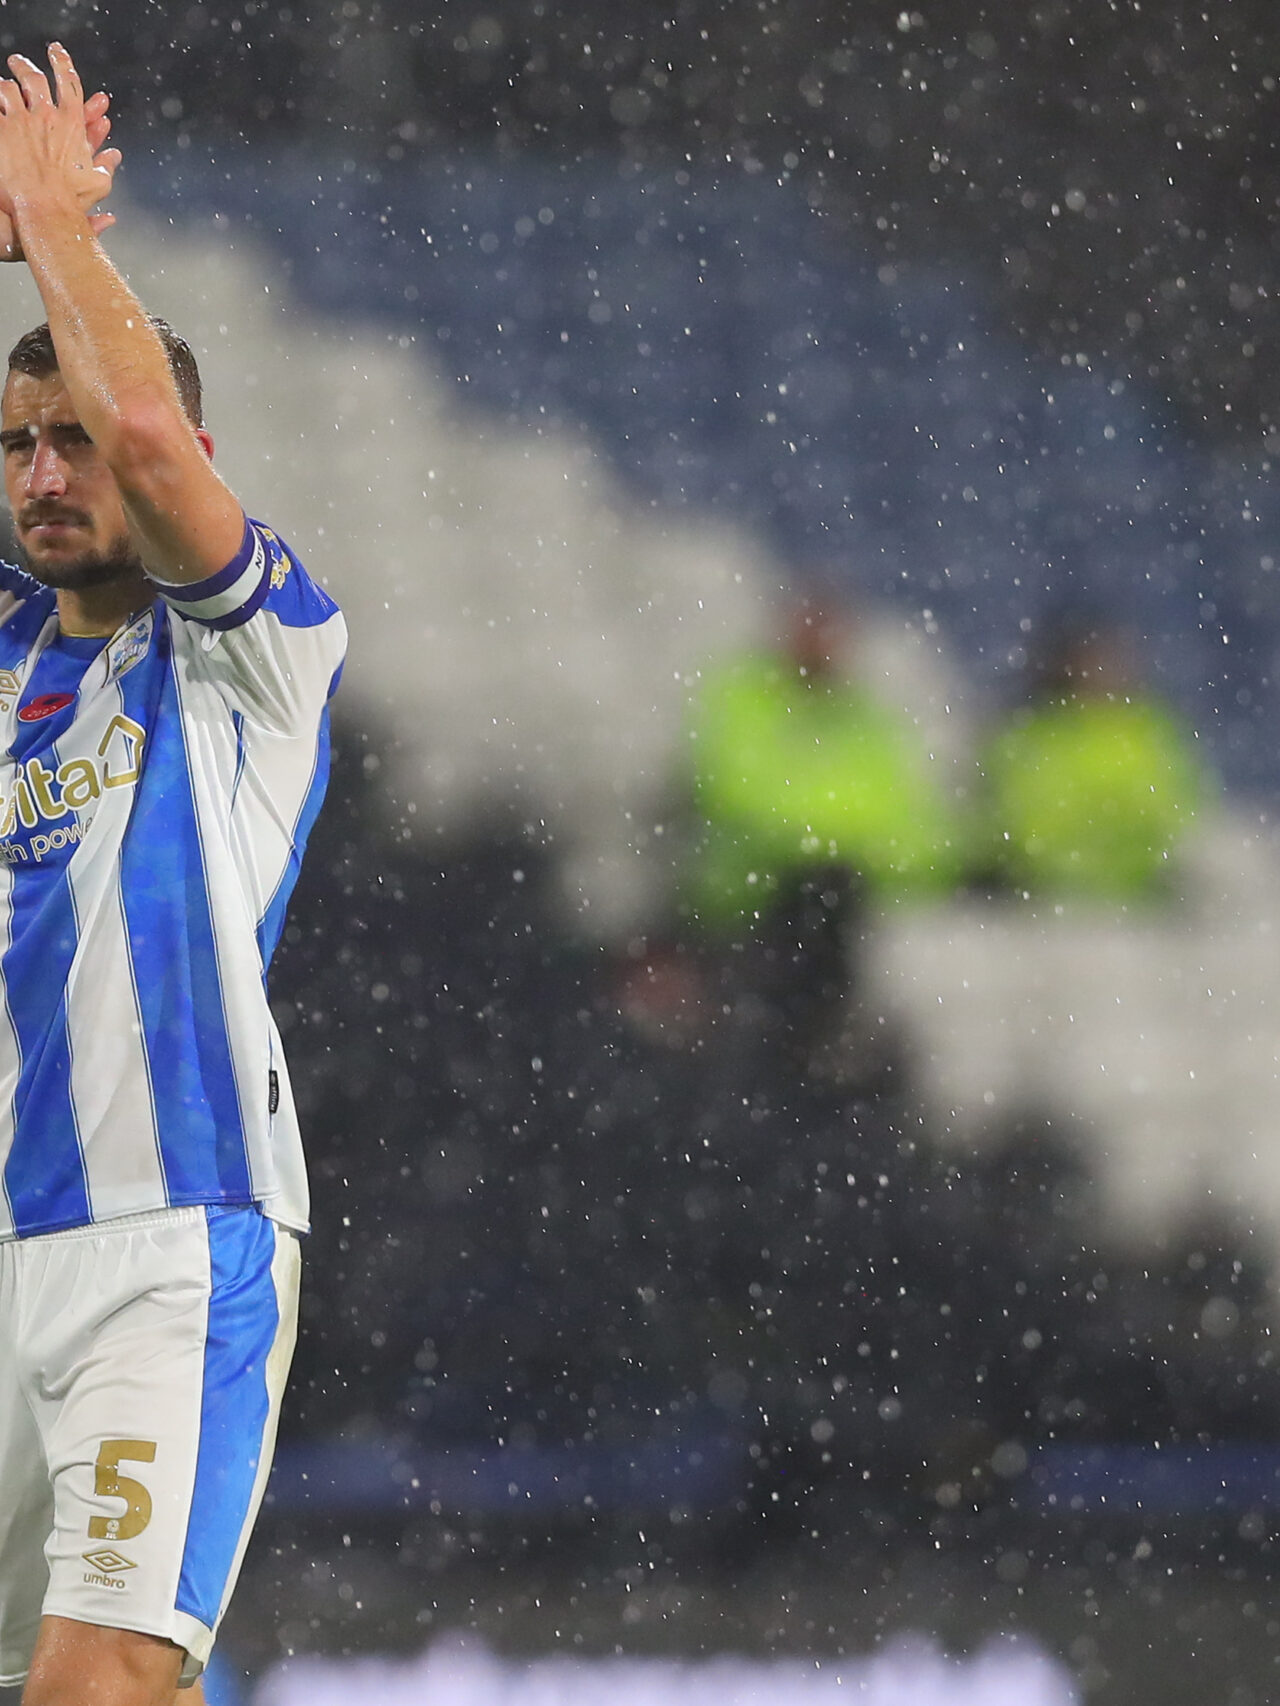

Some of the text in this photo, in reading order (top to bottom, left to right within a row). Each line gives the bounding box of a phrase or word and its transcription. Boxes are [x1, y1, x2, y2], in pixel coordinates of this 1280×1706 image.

[30, 814, 94, 862] powe
[88, 1439, 157, 1541] 5
[83, 1572, 126, 1590] umbro
